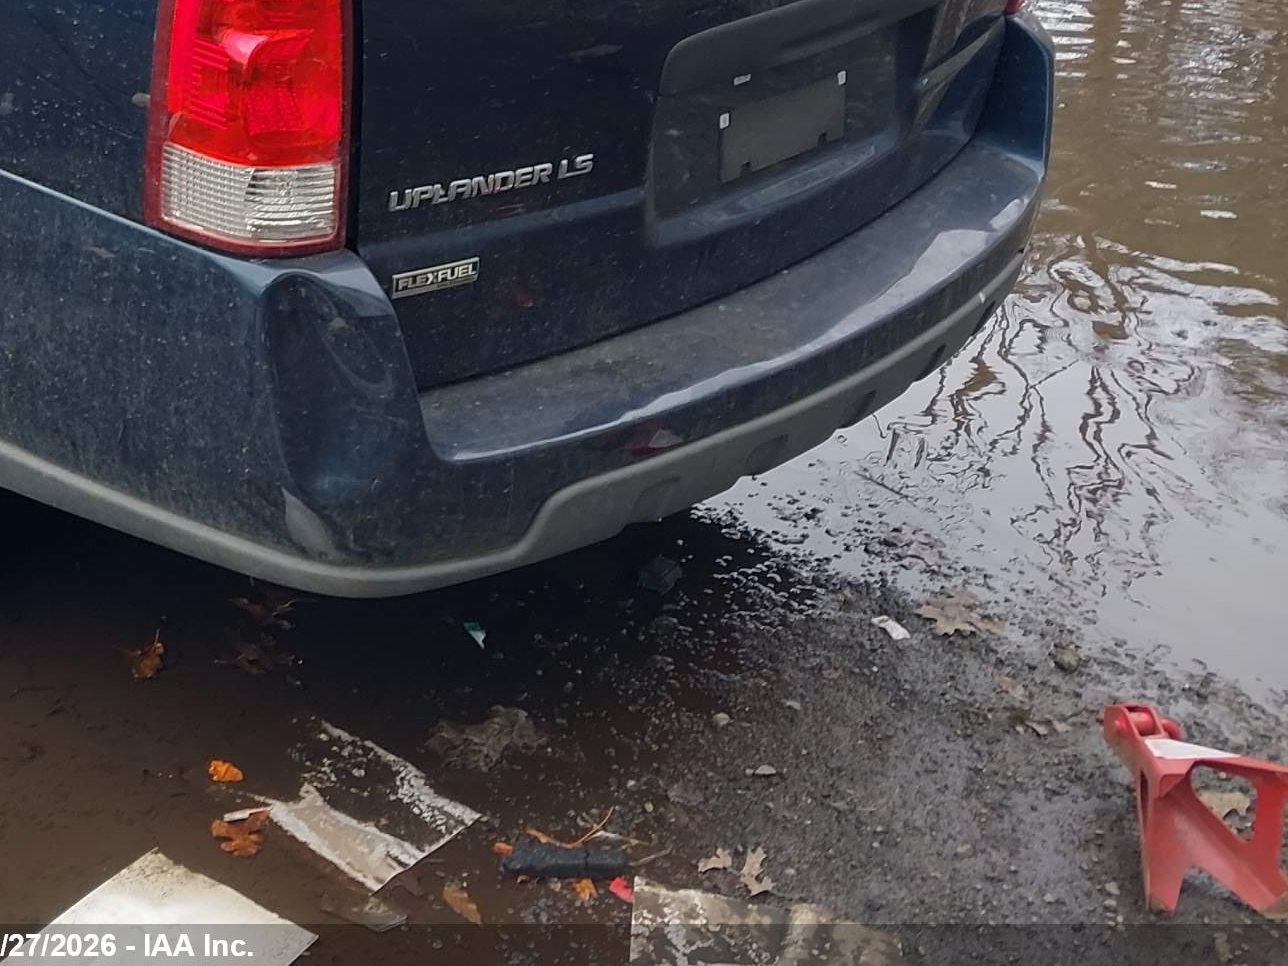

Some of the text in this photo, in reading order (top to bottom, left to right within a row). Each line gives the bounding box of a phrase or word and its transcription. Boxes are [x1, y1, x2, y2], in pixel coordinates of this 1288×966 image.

[389, 154, 594, 212] UPLANDER LS
[397, 263, 477, 291] FLEXFUEL
